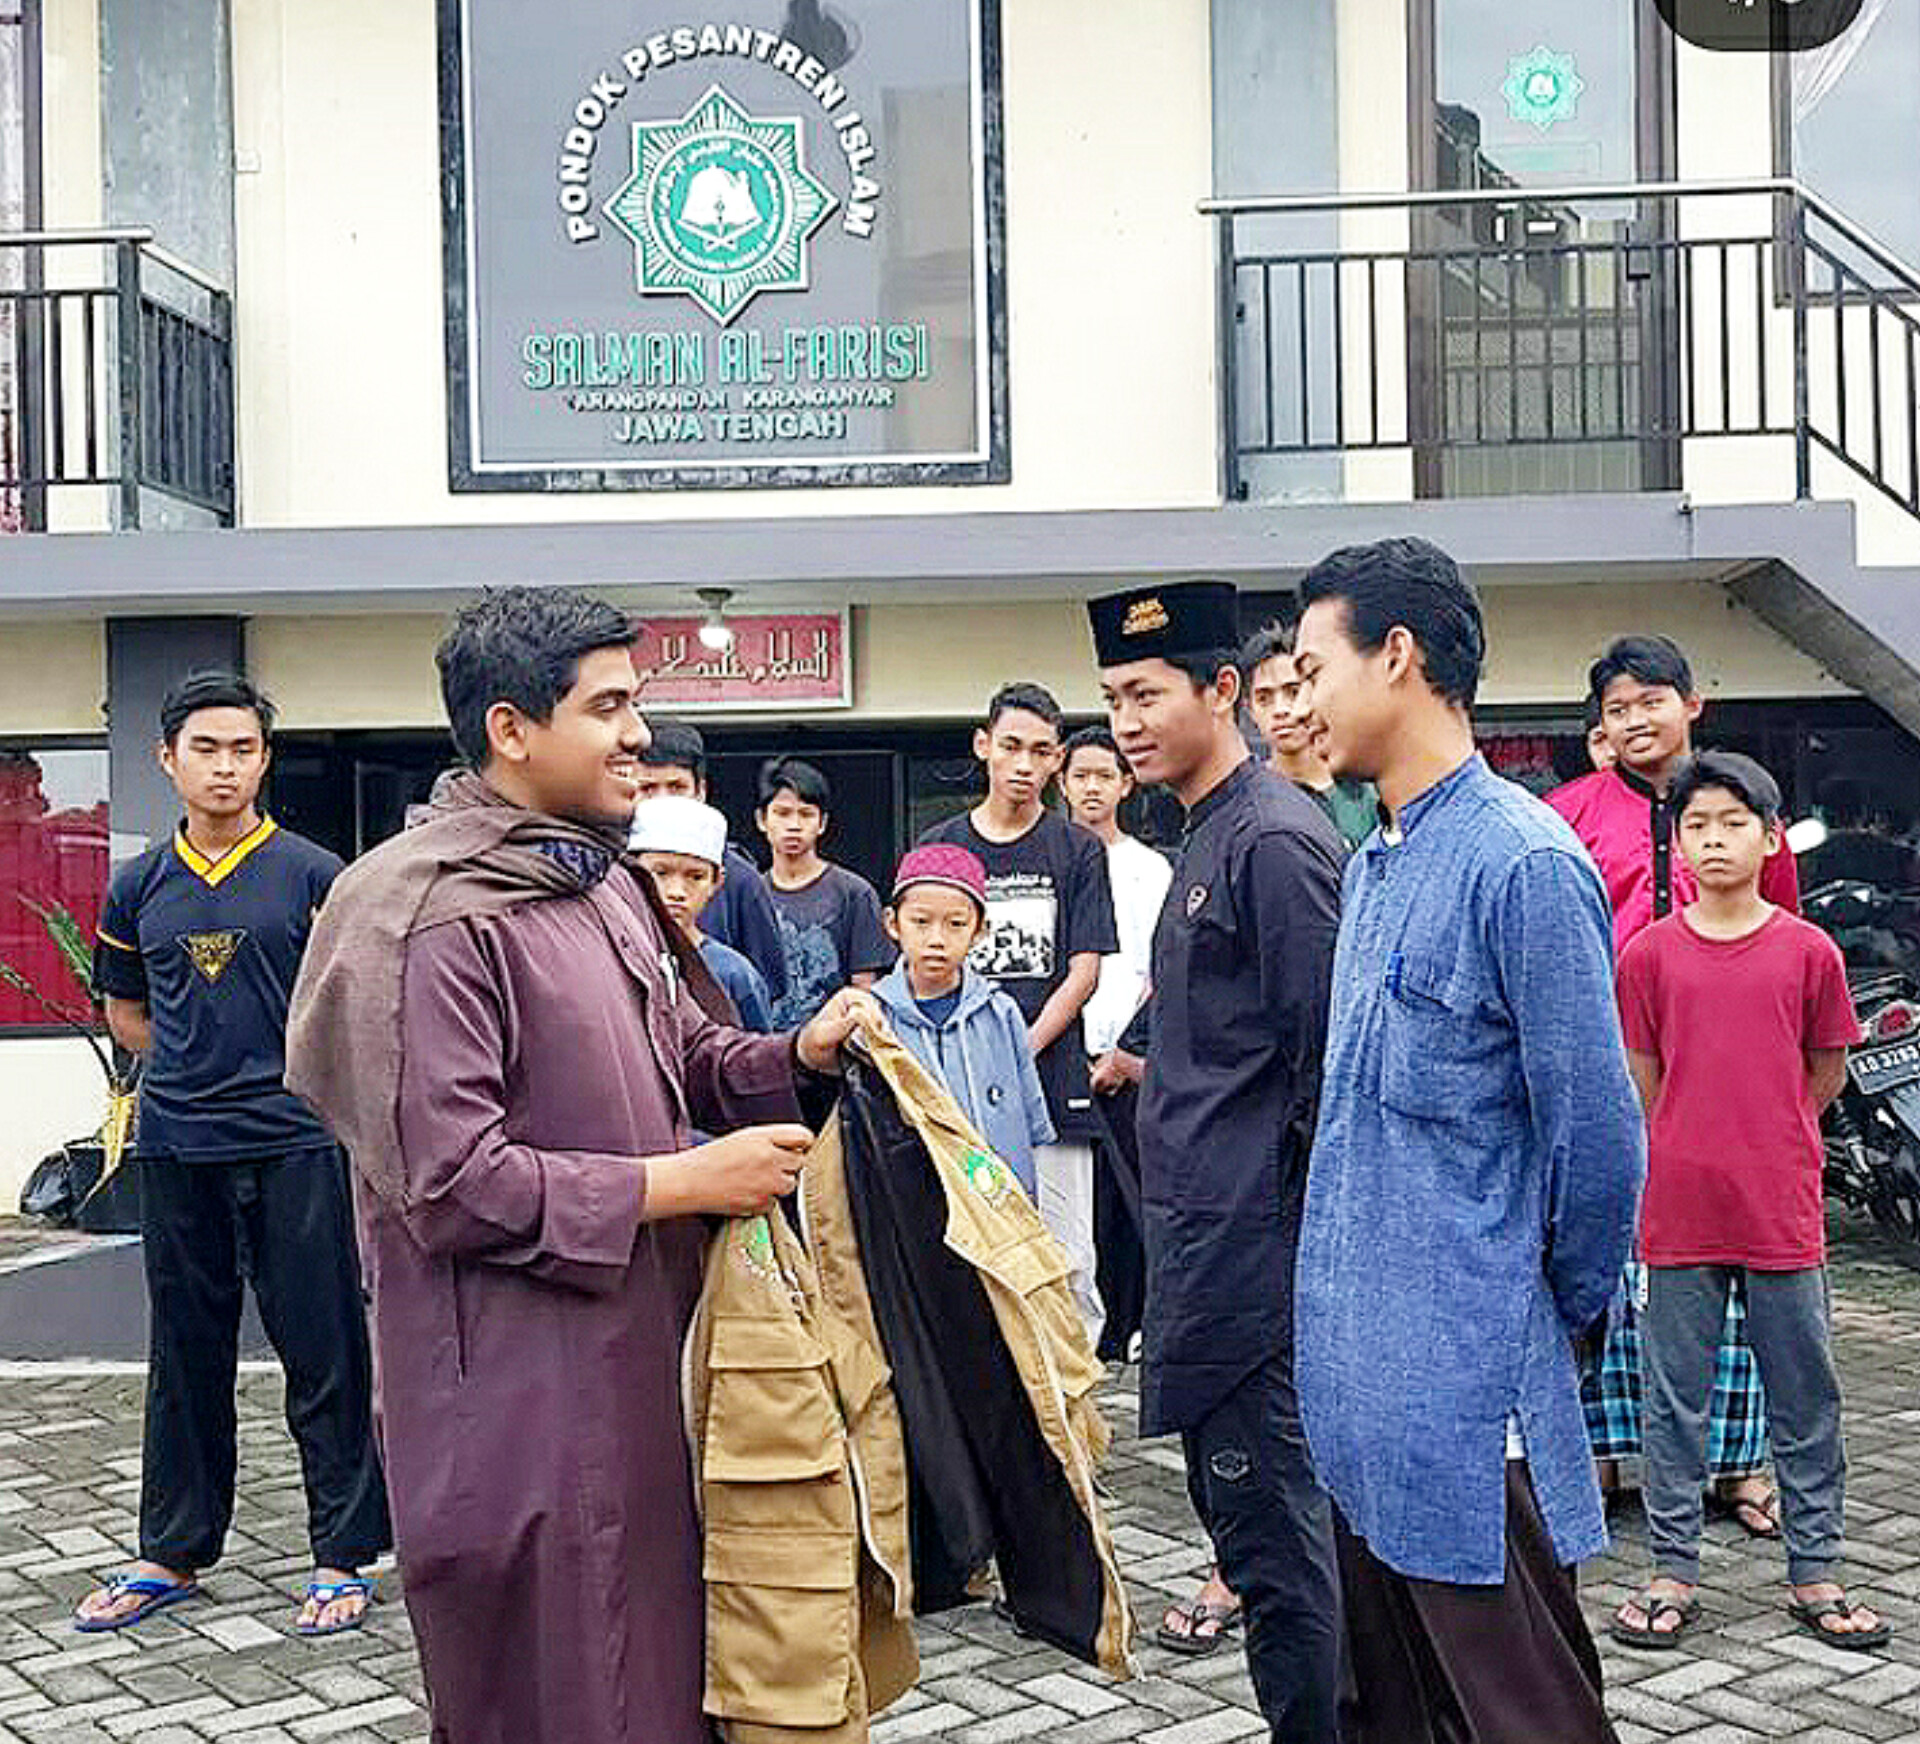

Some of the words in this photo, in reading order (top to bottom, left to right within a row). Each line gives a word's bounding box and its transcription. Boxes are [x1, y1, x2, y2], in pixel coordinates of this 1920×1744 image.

[560, 72, 626, 242] PONDOK
[622, 24, 846, 110] PESANTREN
[834, 111, 880, 238] ISLAM
[523, 330, 704, 390] SALMAN
[719, 324, 929, 384] AL-FARISI
[565, 389, 729, 412] ARANGPANDAN
[613, 413, 704, 443] JAWA
[711, 411, 846, 441] TENGAH
